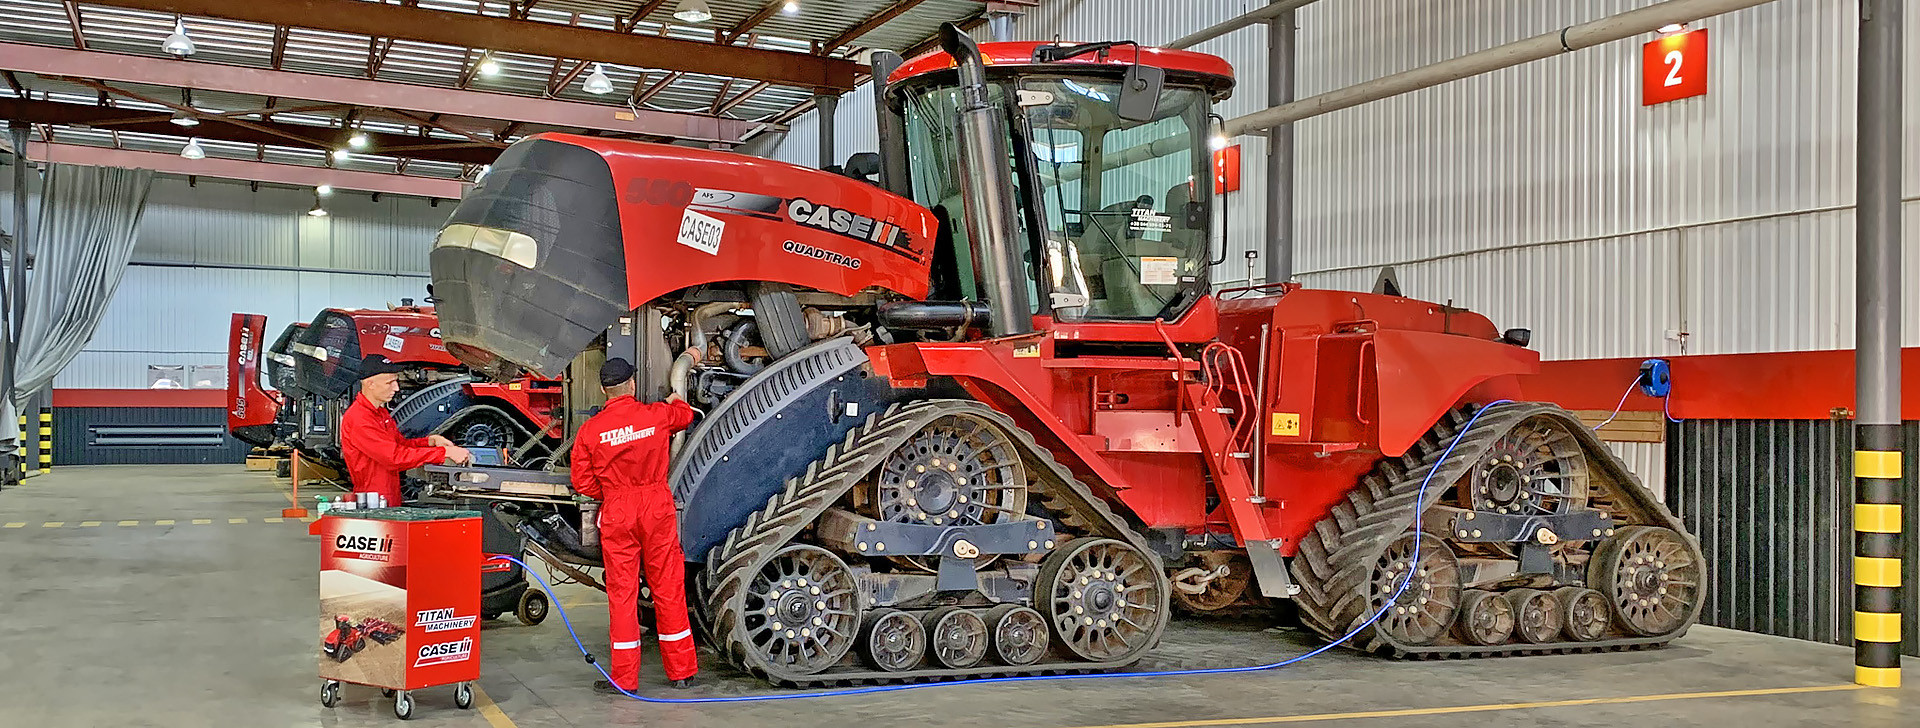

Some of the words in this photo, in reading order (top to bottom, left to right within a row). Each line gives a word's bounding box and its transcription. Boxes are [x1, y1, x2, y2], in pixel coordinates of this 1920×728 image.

[1664, 50, 1683, 87] 2
[701, 192, 714, 200] AFS
[788, 199, 873, 239] CASE
[1131, 208, 1156, 217] TITAN
[680, 215, 721, 249] CASE03
[783, 240, 862, 269] QUADTRAC
[238, 337, 248, 365] CASE
[600, 425, 633, 441] TITAN
[611, 429, 655, 447] MACHINERY
[336, 534, 378, 551] CASE
[359, 553, 389, 561] AGRICULTURE
[419, 609, 453, 622] TITAN
[427, 620, 473, 630] MACHINERY
[420, 643, 458, 657] CASE
